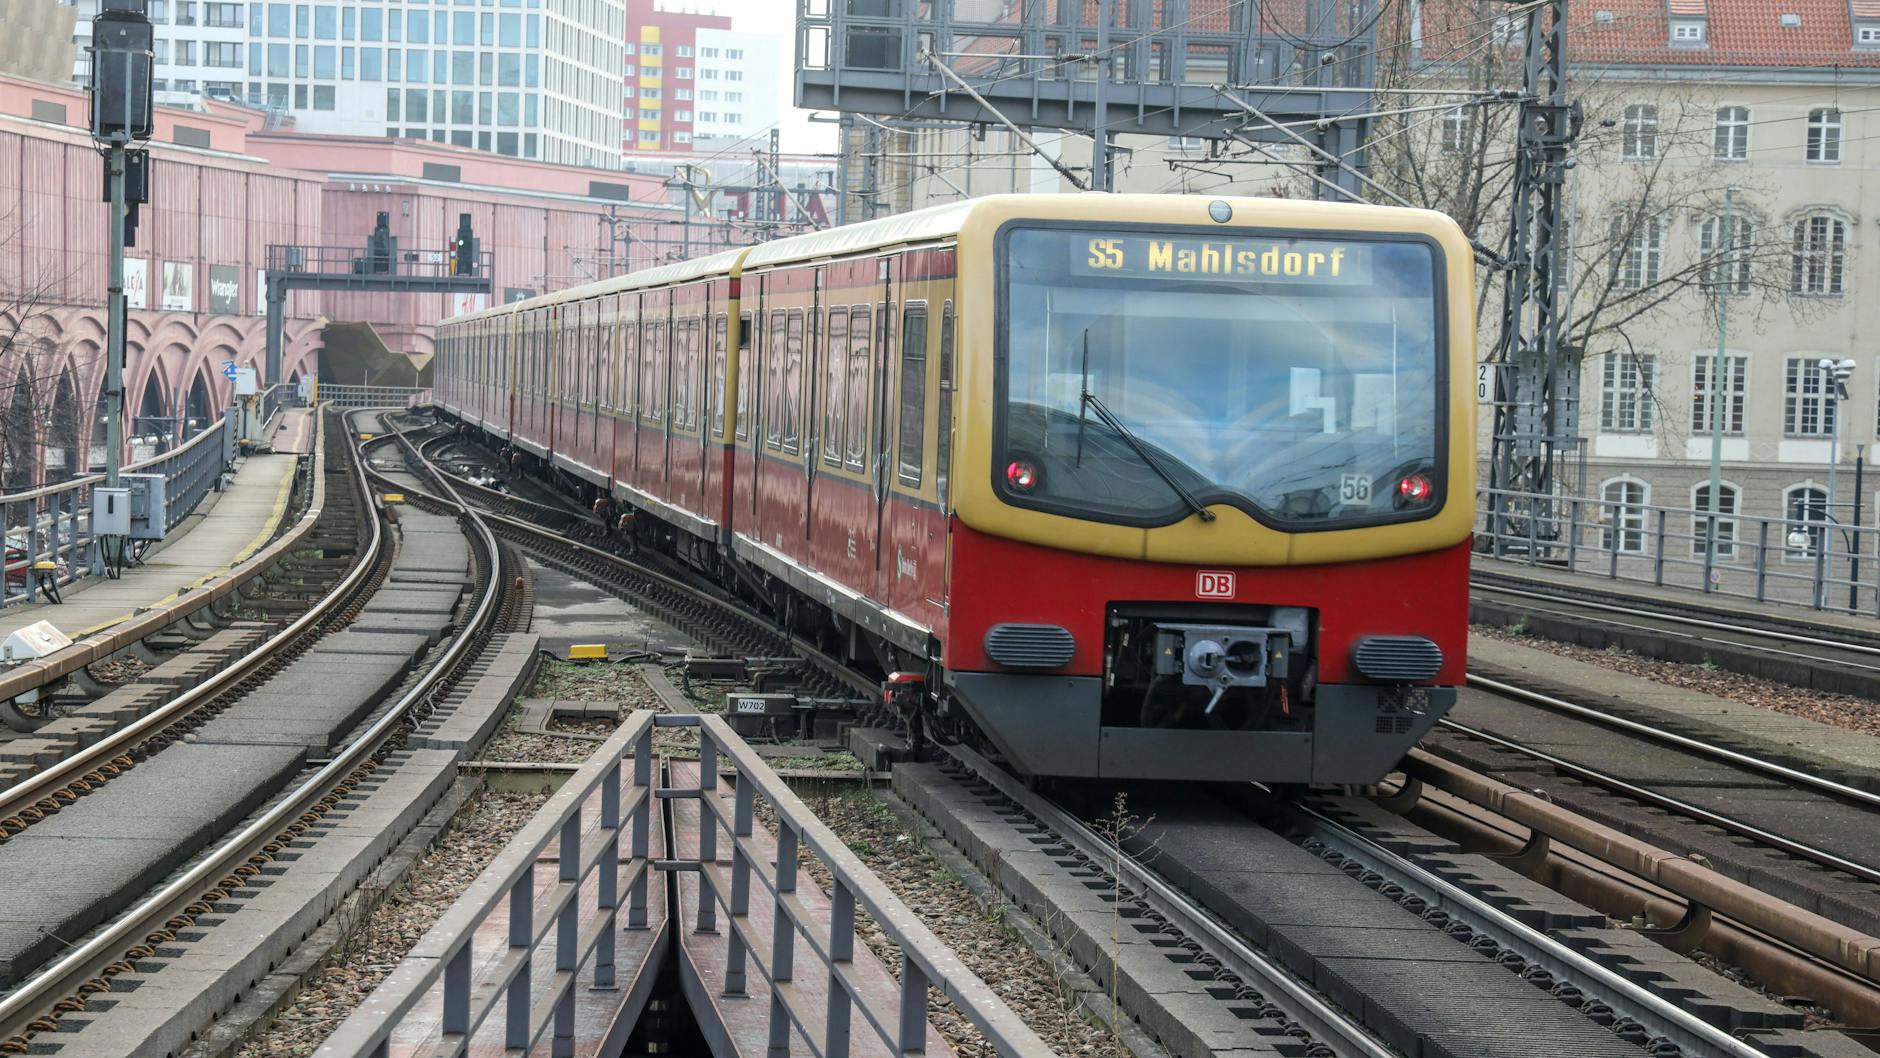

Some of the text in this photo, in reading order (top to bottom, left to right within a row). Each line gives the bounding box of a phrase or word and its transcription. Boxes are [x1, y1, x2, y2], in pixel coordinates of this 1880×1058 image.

[1087, 239, 1346, 277] S5 Mahlsdorf
[211, 278, 239, 305] Wrangler
[1343, 476, 1369, 500] 56
[1201, 575, 1230, 593] DB
[739, 701, 765, 711] W702
